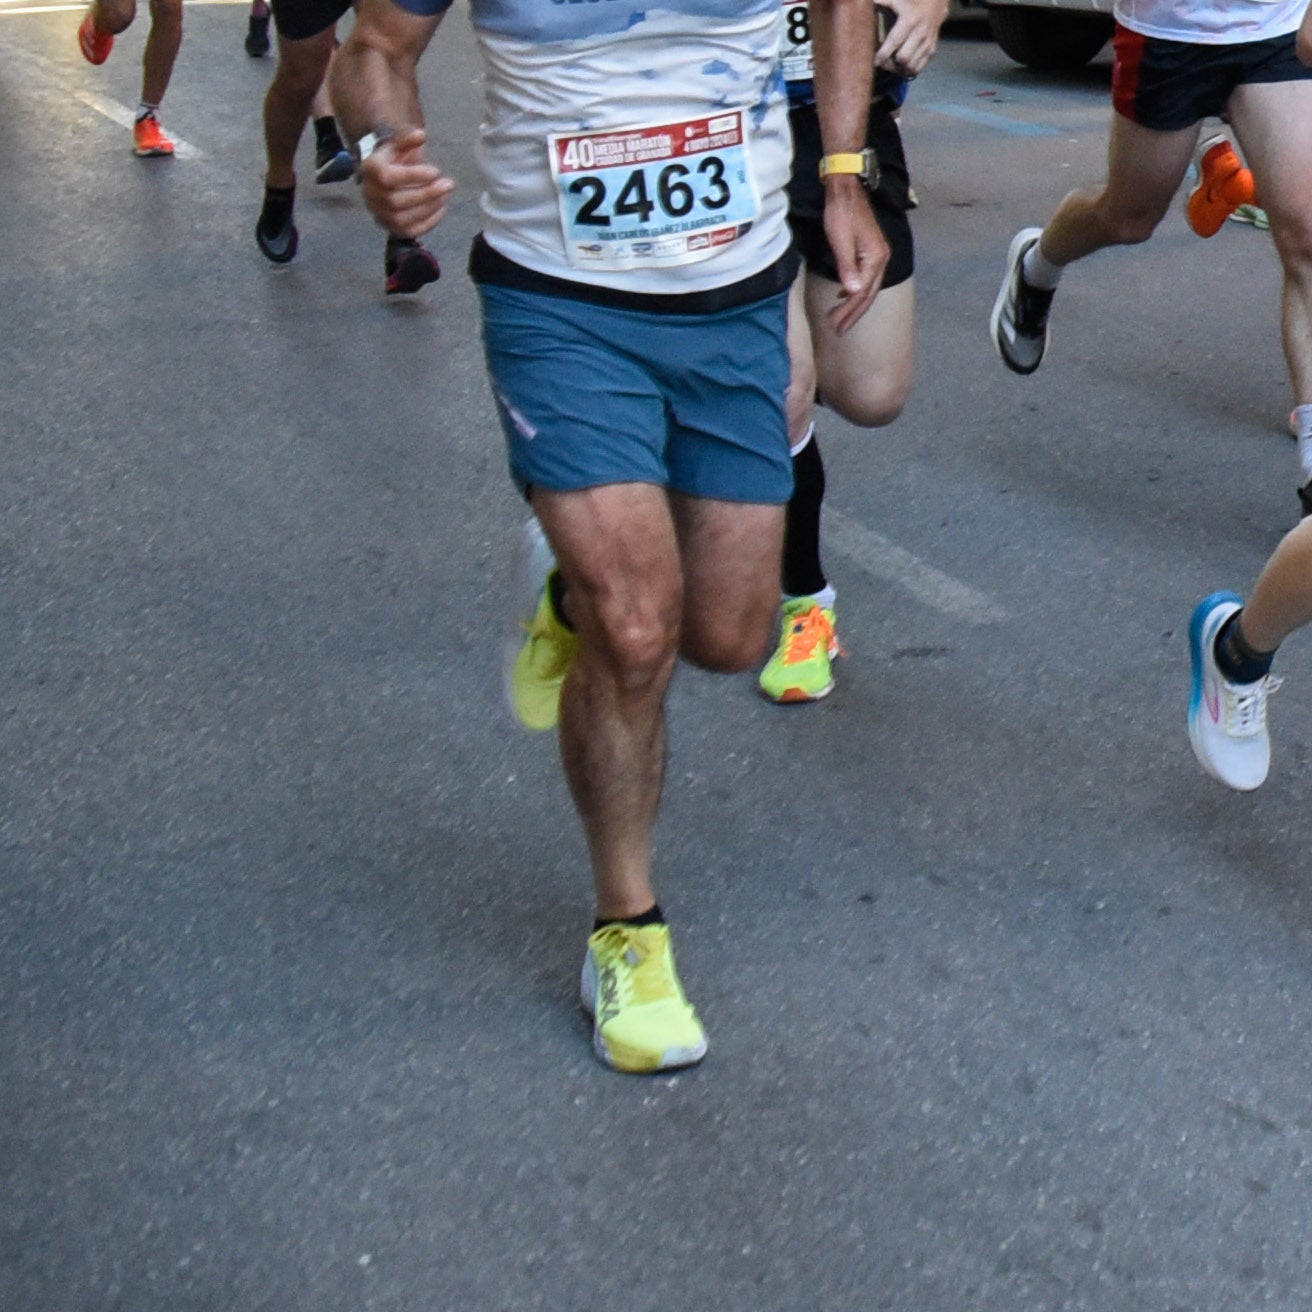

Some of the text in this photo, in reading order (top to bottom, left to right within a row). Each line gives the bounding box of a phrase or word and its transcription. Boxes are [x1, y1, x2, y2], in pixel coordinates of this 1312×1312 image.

[563, 139, 595, 169] 40
[594, 141, 625, 157] MEDIA
[569, 156, 731, 226] 2463
